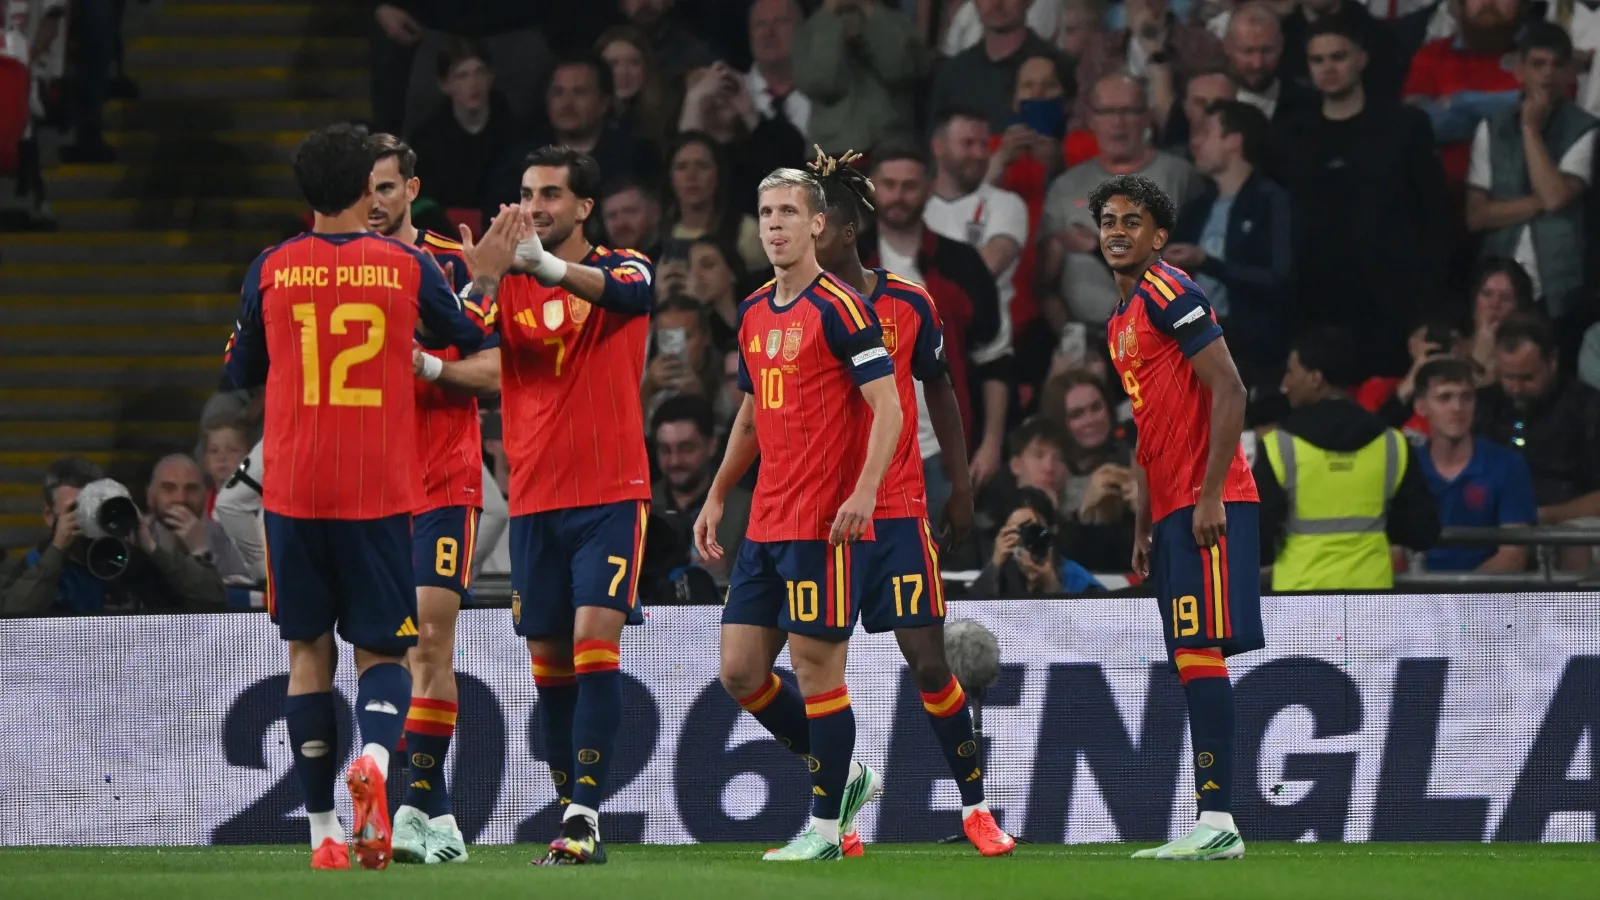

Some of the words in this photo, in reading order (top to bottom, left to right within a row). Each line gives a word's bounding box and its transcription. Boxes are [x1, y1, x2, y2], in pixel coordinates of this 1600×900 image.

[274, 266, 329, 288] MARC
[335, 265, 403, 290] PUBILL
[293, 303, 386, 407] 12
[543, 336, 567, 377] 7
[760, 368, 784, 410] 10
[1123, 370, 1143, 410] 9
[435, 536, 458, 577] 8
[607, 555, 627, 597] 7
[786, 580, 818, 622] 10
[892, 573, 923, 617] 17
[1172, 595, 1199, 639] 19
